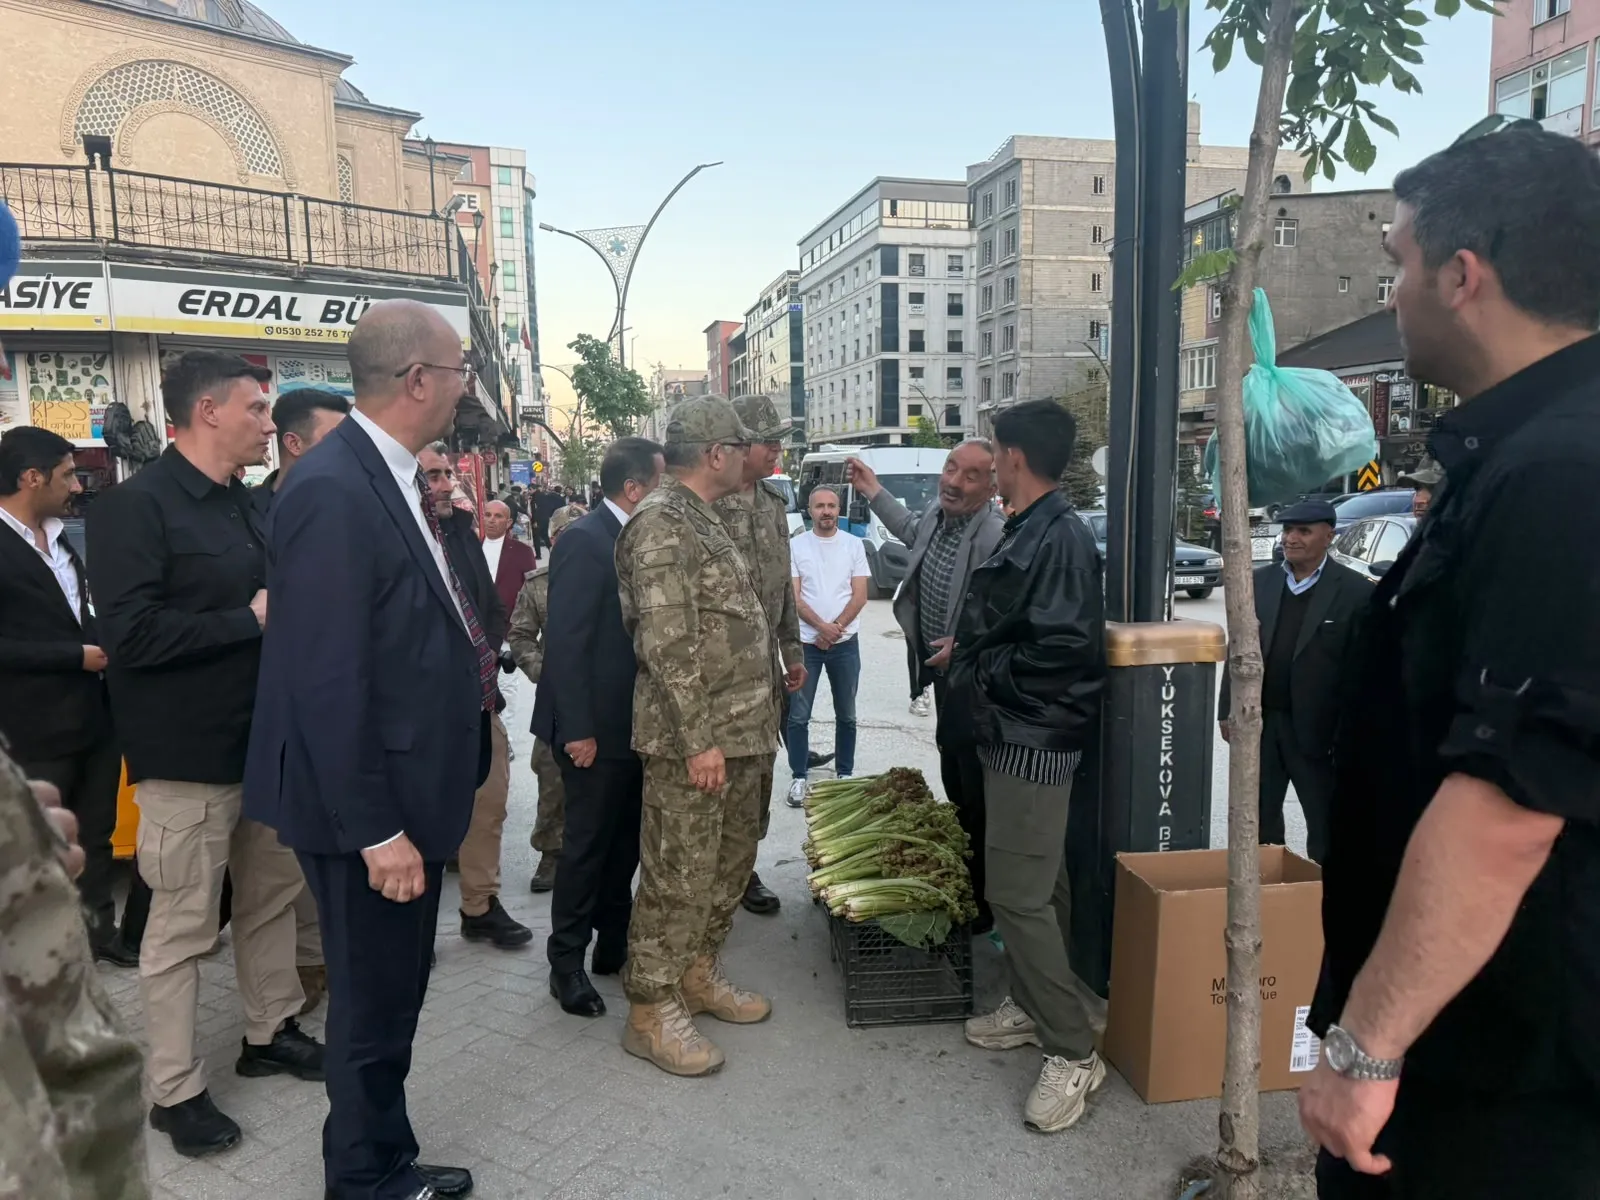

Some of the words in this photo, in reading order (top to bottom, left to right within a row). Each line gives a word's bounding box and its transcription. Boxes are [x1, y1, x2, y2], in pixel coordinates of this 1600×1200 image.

[178, 289, 302, 322] ERDAL
[276, 326, 301, 336] 0530
[305, 328, 323, 338] 252
[326, 330, 338, 338] 76
[32, 400, 87, 421] KPSS
[1158, 666, 1176, 816] YÜKSEKOVA
